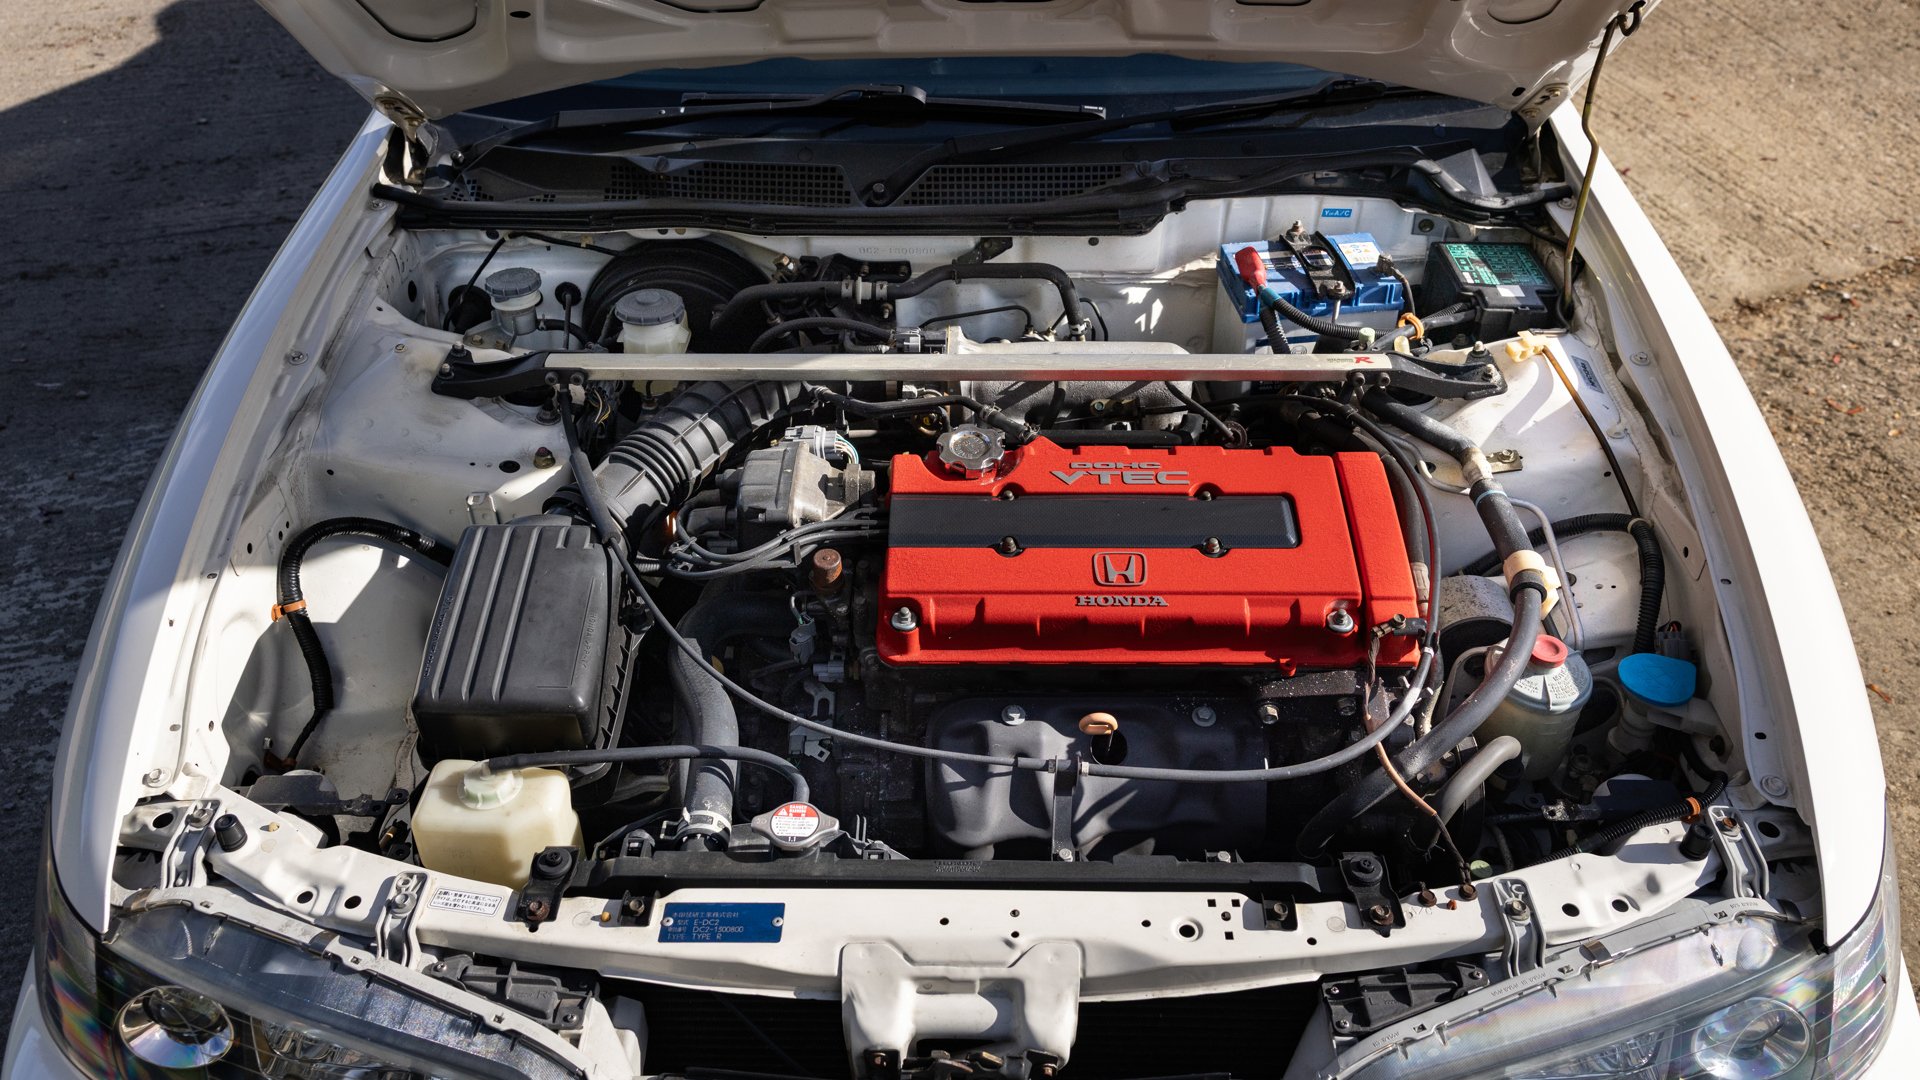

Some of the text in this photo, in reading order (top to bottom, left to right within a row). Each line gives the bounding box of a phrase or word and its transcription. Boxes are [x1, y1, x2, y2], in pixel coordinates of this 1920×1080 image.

[1069, 461, 1161, 469] DOHC
[1049, 470, 1190, 485] VTEC
[1075, 595, 1169, 607] HONDA
[692, 932, 712, 940] TYPE
[715, 932, 723, 940] R
